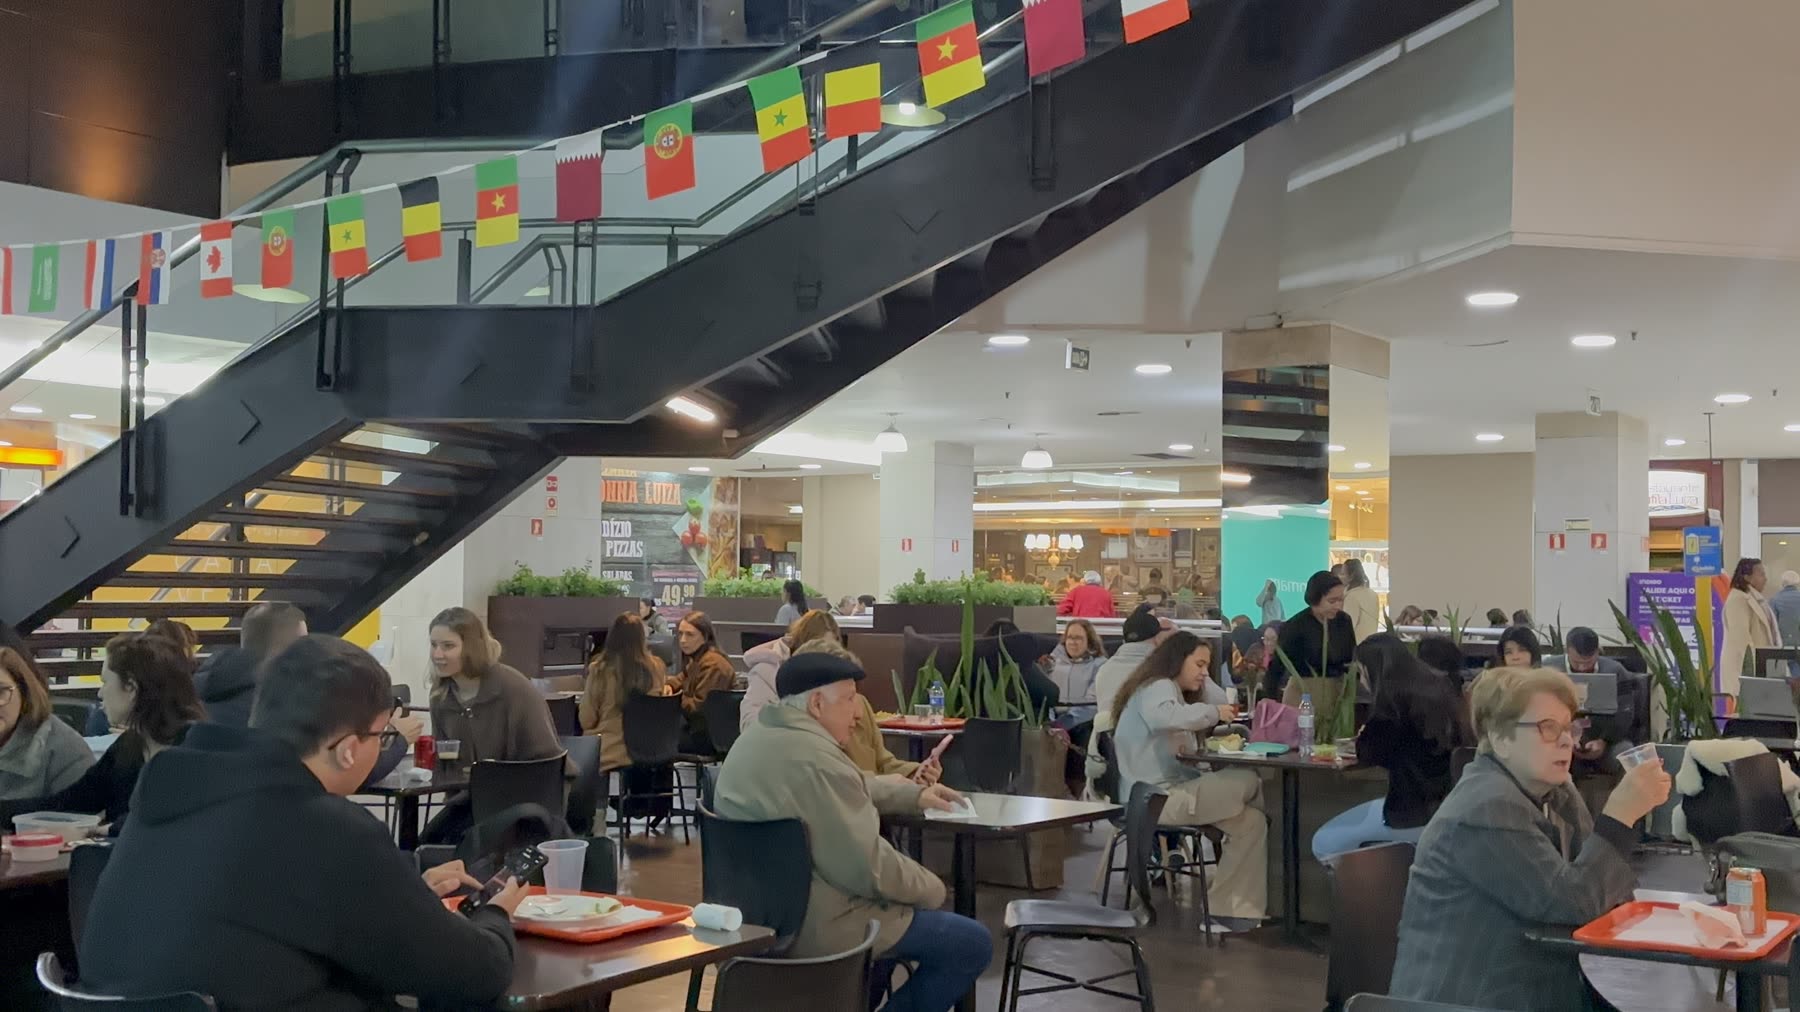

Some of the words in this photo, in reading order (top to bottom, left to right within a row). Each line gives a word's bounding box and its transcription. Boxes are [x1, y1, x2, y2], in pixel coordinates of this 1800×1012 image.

[645, 482, 681, 505] LUIZA
[601, 518, 632, 538] DÍZIO
[605, 540, 644, 558] PIZZAS
[1667, 587, 1688, 595] AQUI
[1688, 587, 1695, 595] O
